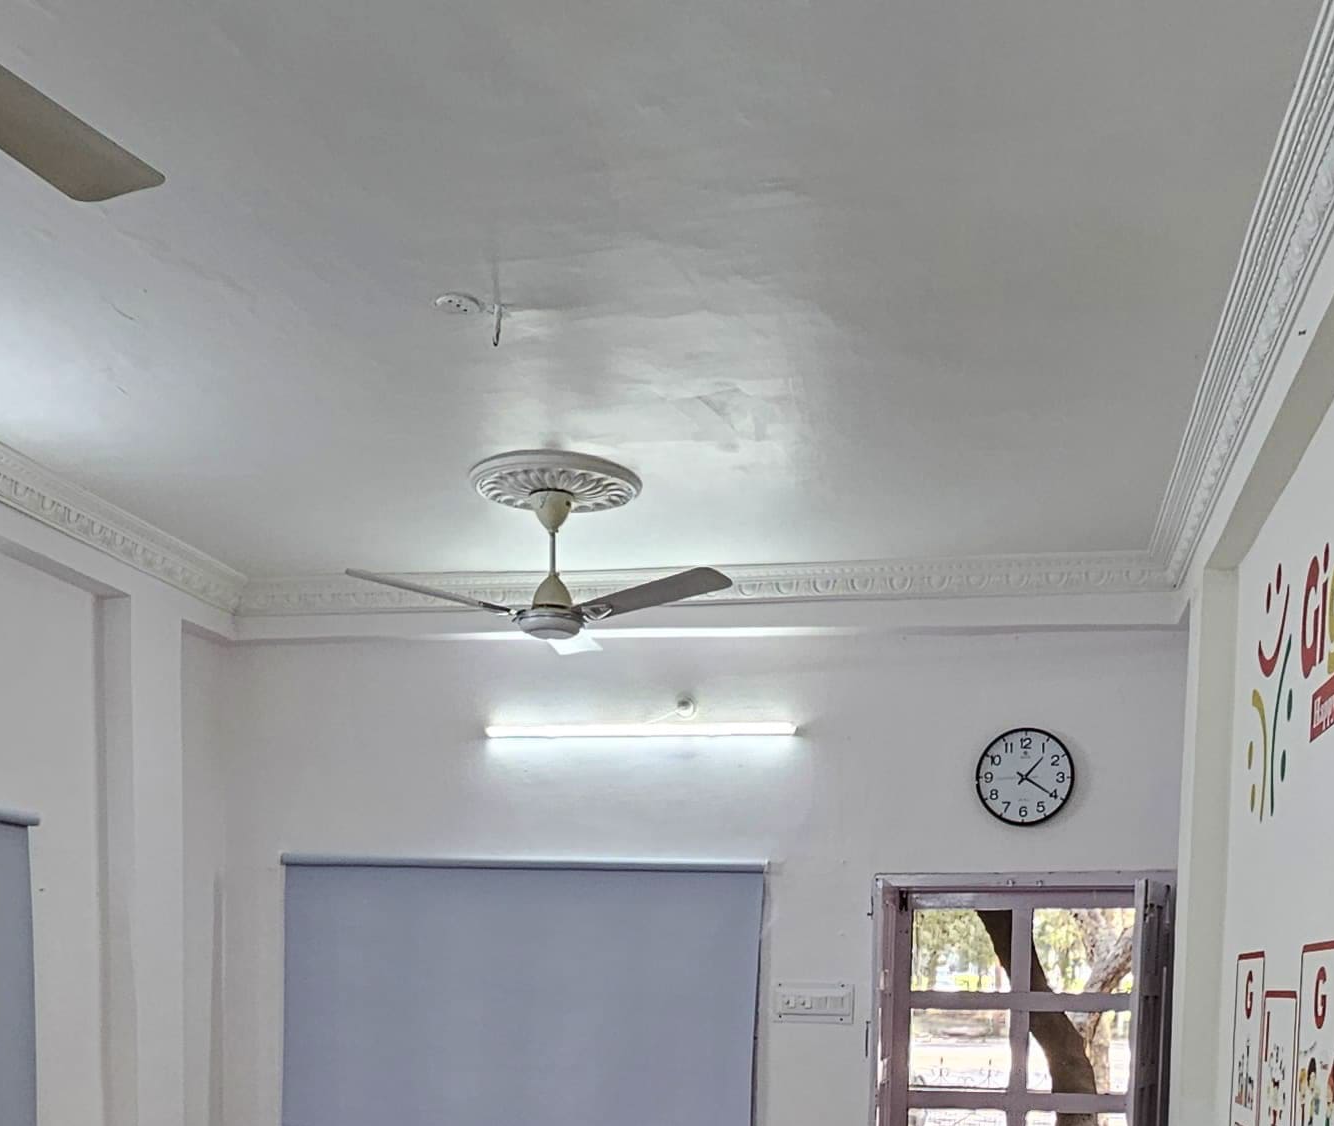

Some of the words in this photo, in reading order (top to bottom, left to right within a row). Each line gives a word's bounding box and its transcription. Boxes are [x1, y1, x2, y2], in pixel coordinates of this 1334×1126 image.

[1004, 742, 1014, 754] 11
[1020, 737, 1032, 749] 12
[990, 754, 1002, 766] 10
[1050, 754, 1060, 766] 2
[984, 771, 994, 783] 9
[1056, 771, 1065, 783] 3
[989, 789, 999, 800] 8
[1049, 788, 1058, 800] 4
[1002, 801, 1011, 813] 7
[1018, 806, 1028, 818] 6
[1036, 801, 1045, 813] 5
[1244, 969, 1253, 1020] G
[1313, 966, 1327, 1030] G
